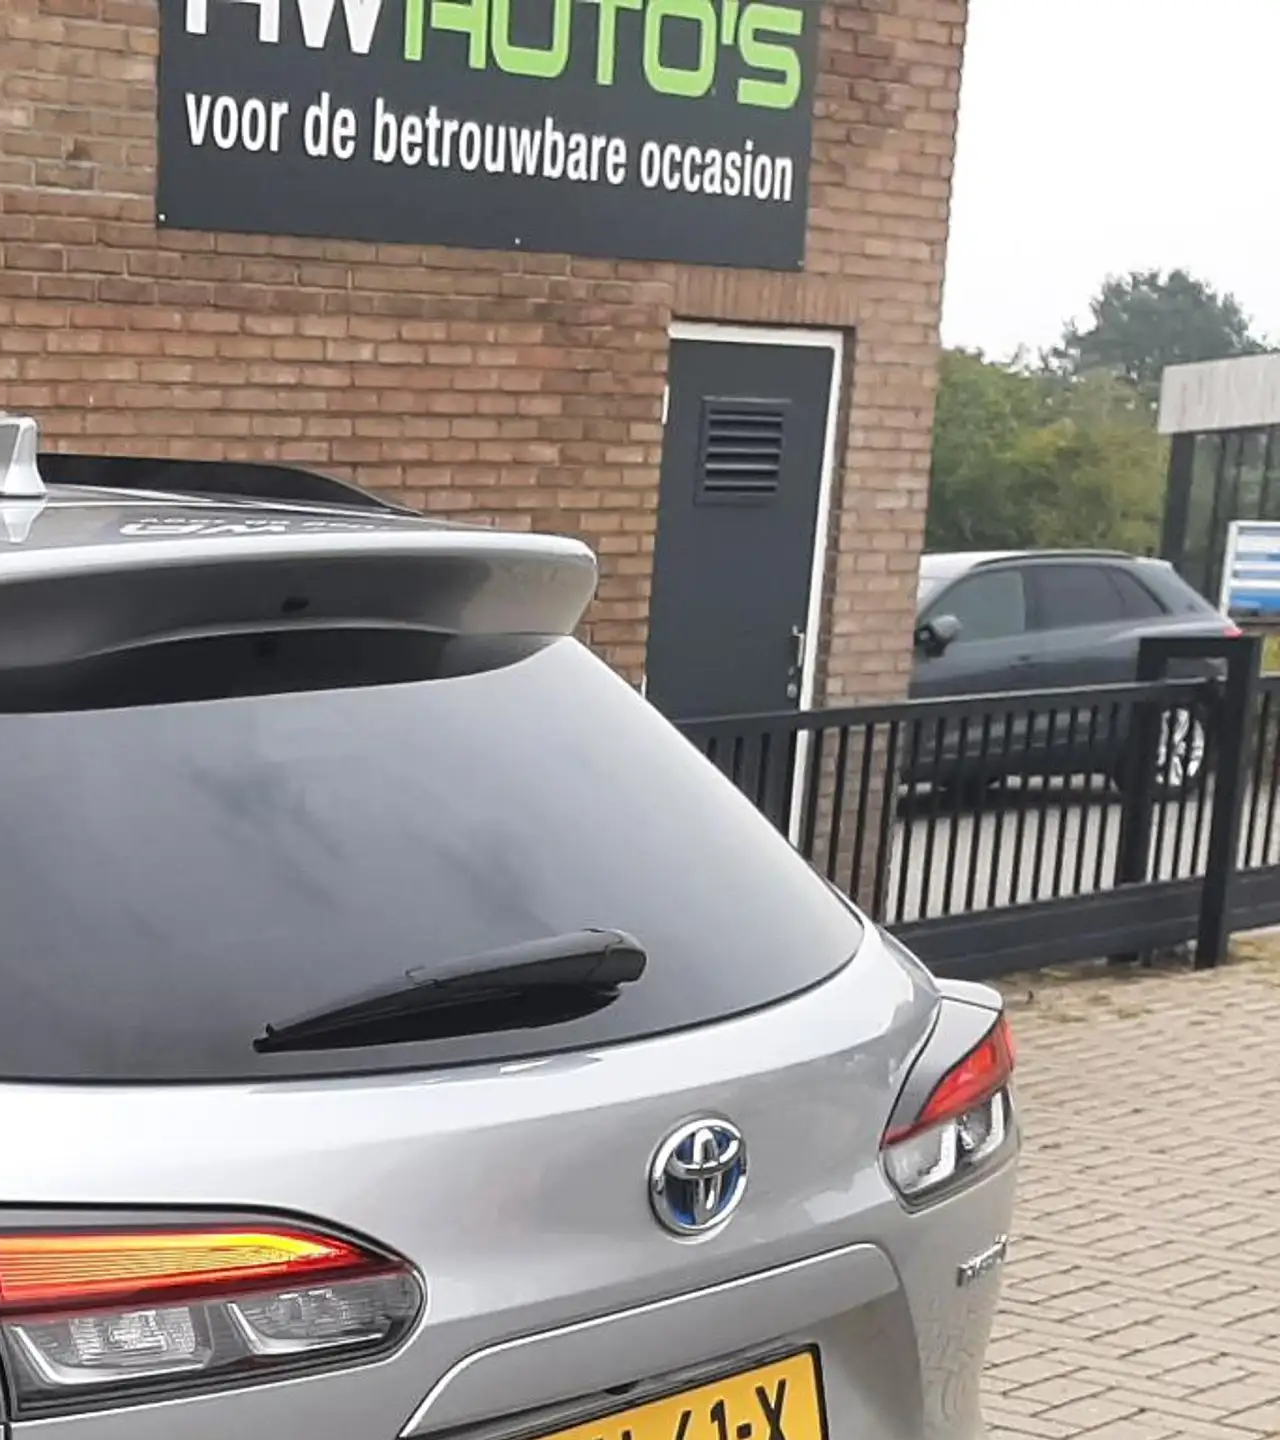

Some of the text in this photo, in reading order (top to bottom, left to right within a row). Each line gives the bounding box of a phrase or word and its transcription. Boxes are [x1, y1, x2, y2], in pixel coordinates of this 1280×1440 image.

[186, 92, 793, 202] voor de betrouwbare occasion
